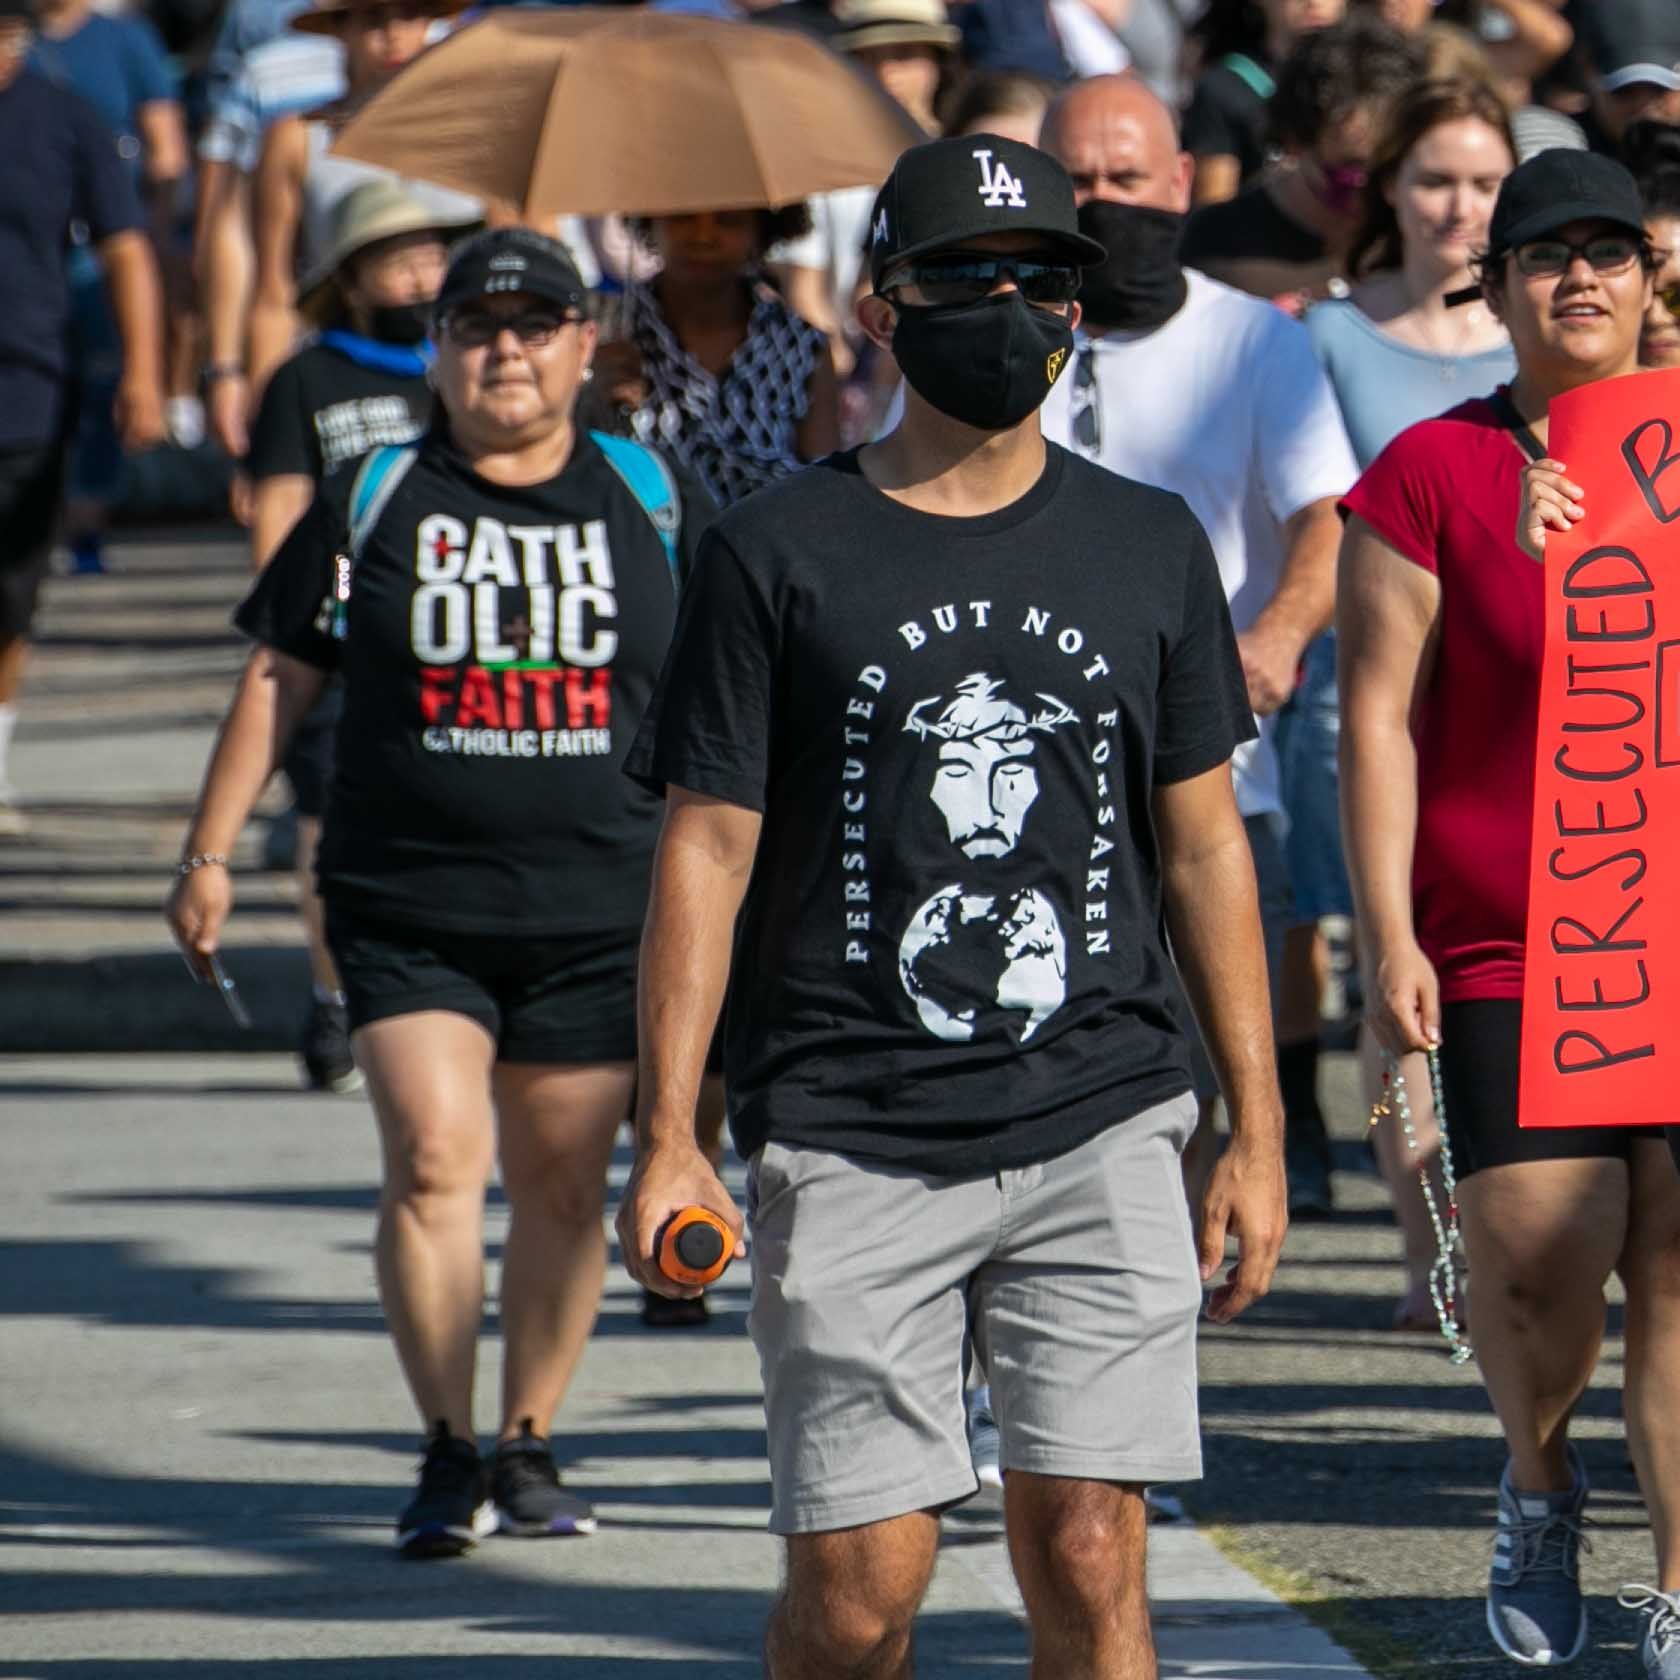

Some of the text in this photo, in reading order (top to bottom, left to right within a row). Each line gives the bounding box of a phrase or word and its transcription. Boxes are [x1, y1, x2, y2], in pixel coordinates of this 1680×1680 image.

[972, 149, 1027, 207] LA
[417, 513, 616, 589] CATH
[410, 580, 619, 667] OLIC
[418, 665, 612, 731] FAITH
[422, 727, 611, 758] CATHOLIC FAITH
[843, 600, 1120, 963] PERSECUTED BUT NOT FORSAKEN
[1550, 545, 1655, 1075] PERSECUTED
